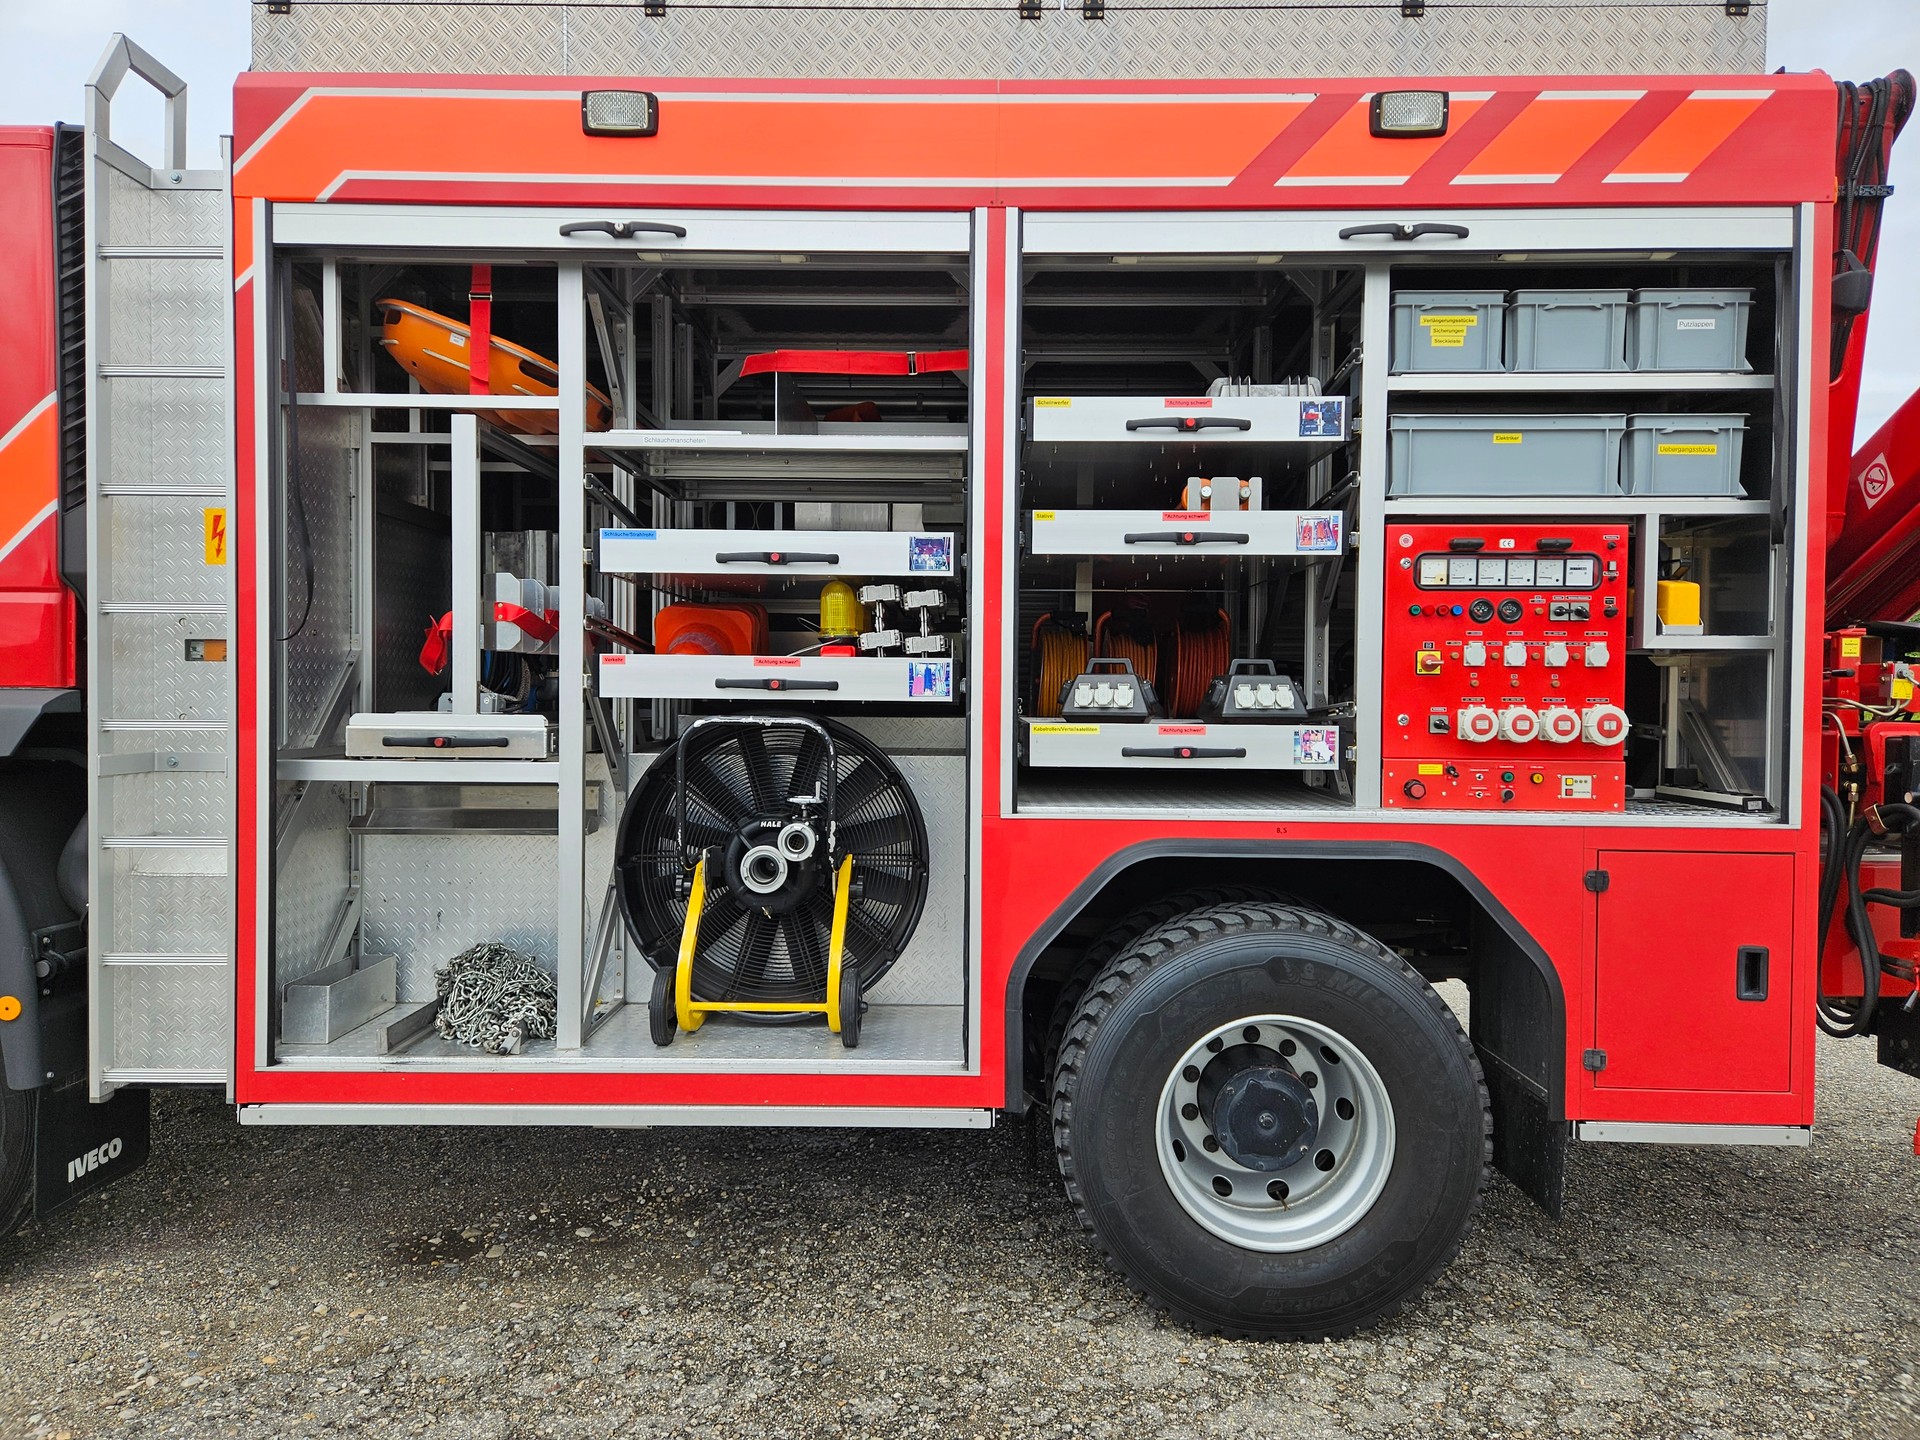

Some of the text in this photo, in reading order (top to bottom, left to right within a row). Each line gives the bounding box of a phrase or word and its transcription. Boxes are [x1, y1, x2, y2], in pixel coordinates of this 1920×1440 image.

[1679, 320, 1713, 328] Putzlappen
[1659, 445, 1715, 453] Uebergangsstücke
[760, 820, 782, 828] HALE
[67, 1137, 123, 1184] IVECO
